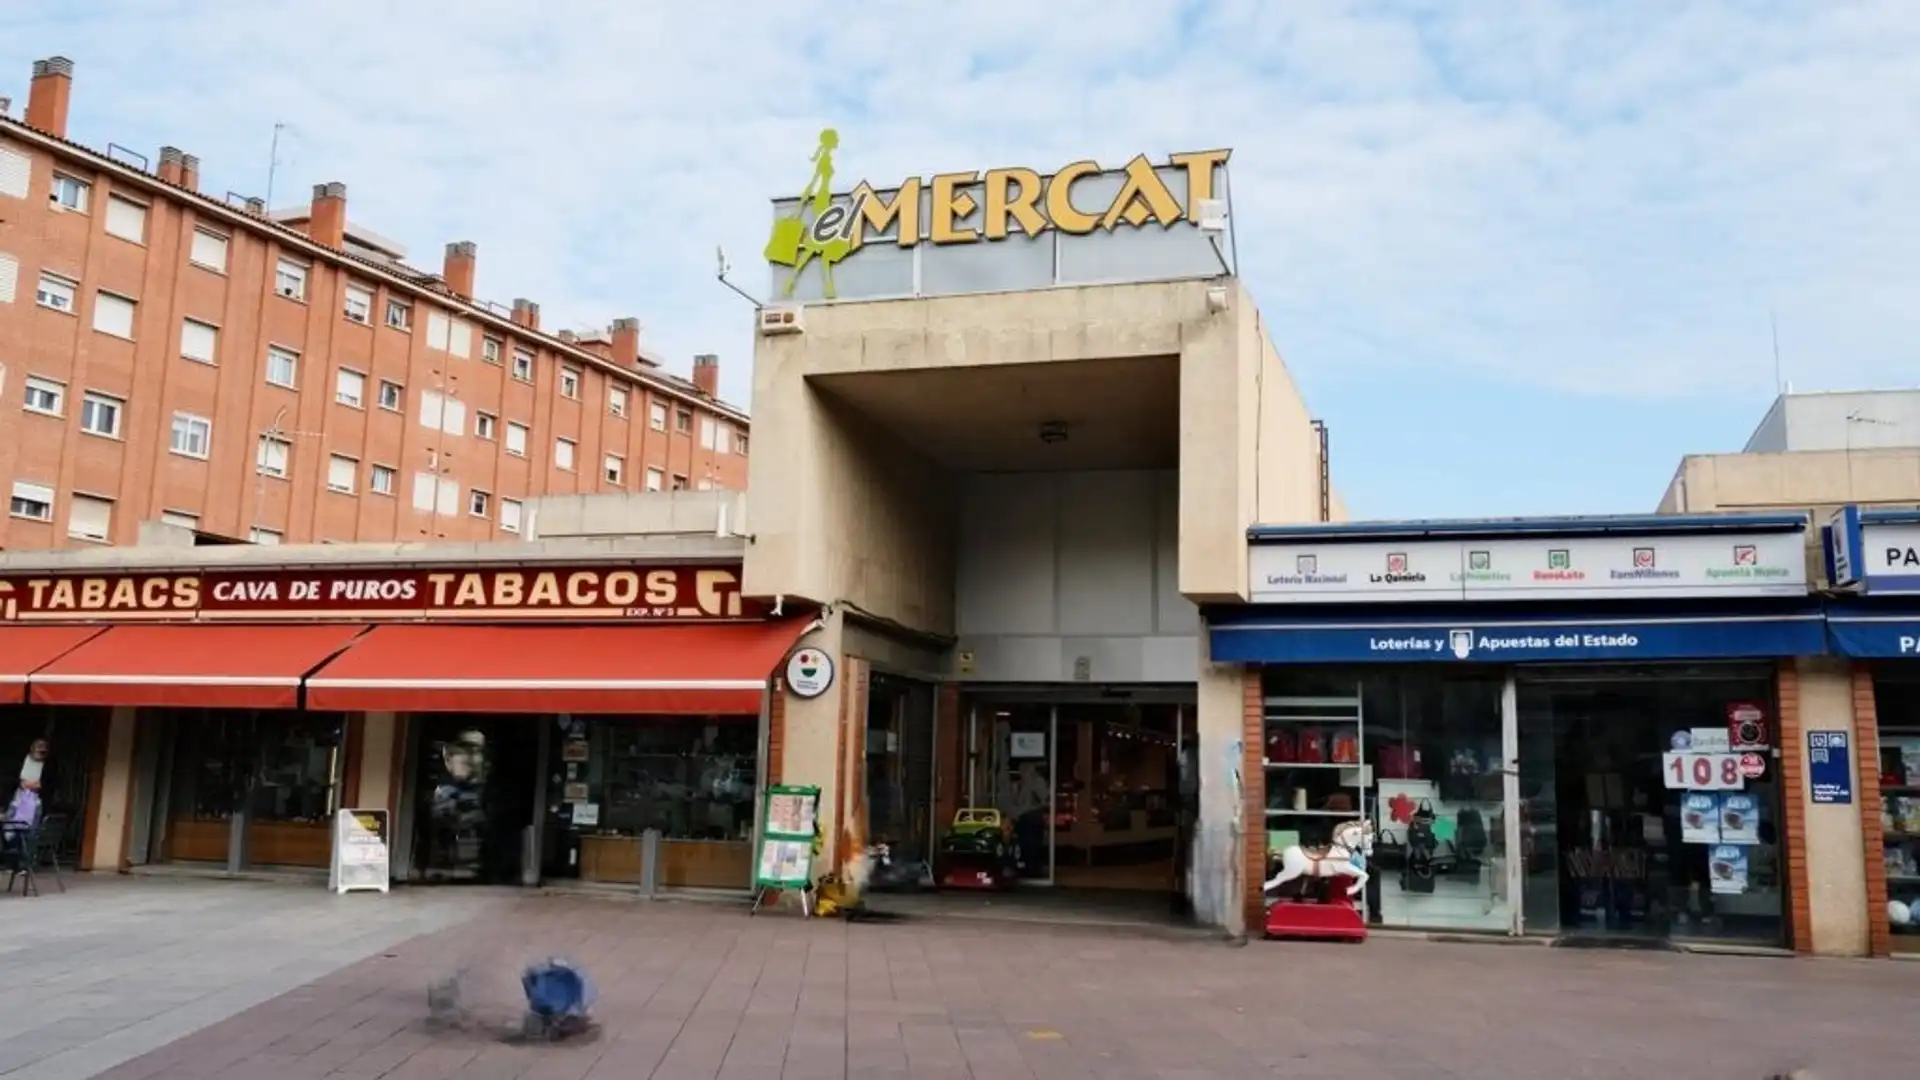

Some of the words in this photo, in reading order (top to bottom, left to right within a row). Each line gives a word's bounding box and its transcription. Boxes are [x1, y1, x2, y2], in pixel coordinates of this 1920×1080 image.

[812, 193, 867, 243] el
[851, 148, 1234, 249] MERCAT
[28, 577, 200, 608] TABACS
[212, 581, 279, 600] CAVA
[288, 581, 321, 600] DE
[330, 579, 417, 600] PUROS
[428, 570, 677, 606] TABACOS
[1434, 639, 1444, 652] y
[1479, 636, 1550, 650] Apuestas
[1555, 634, 1578, 647] del
[1584, 634, 1638, 647] Estado
